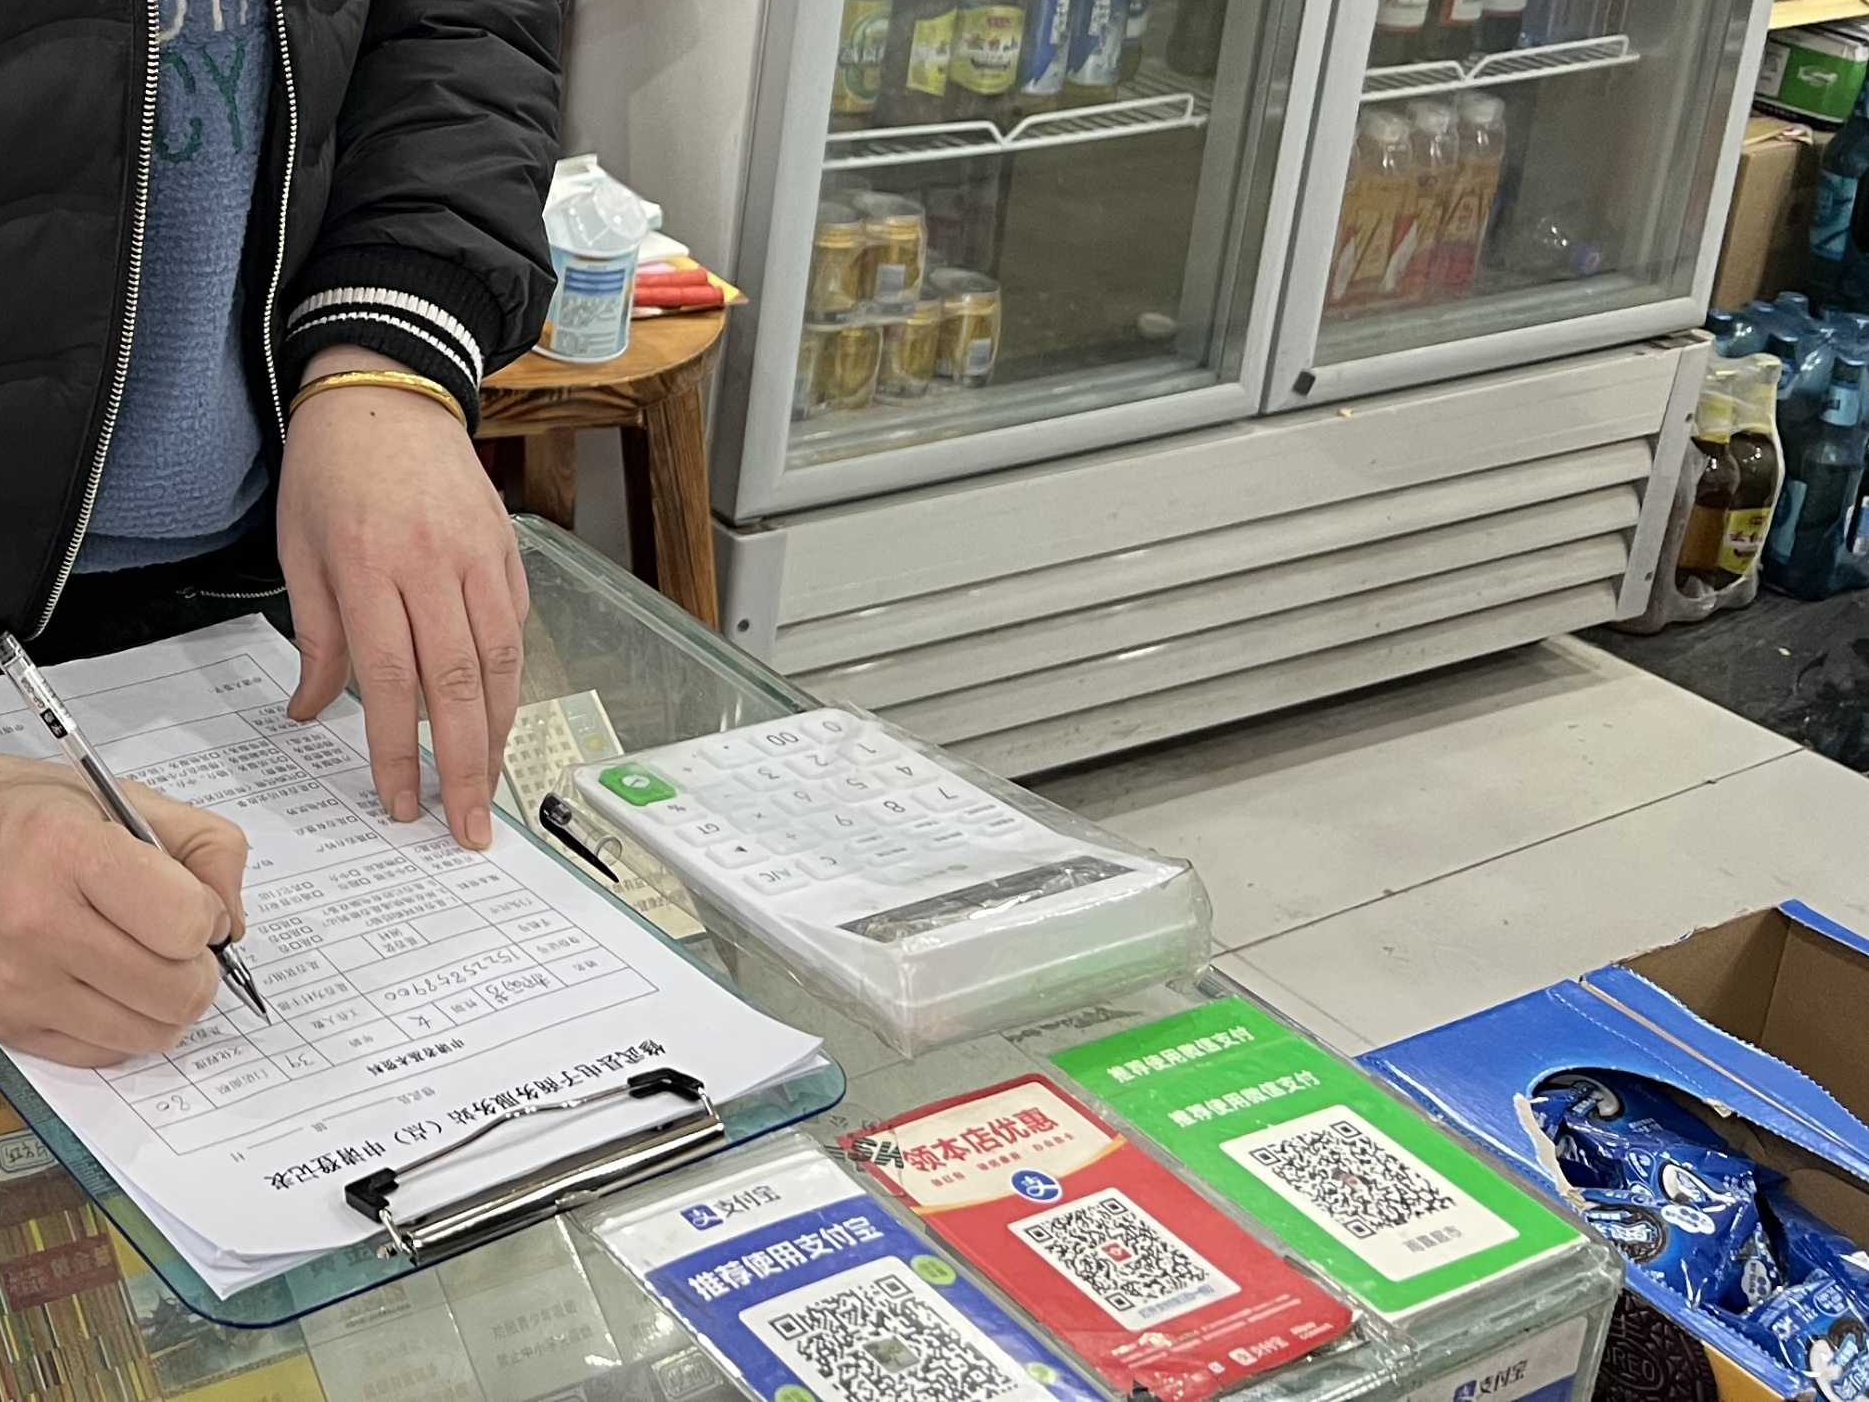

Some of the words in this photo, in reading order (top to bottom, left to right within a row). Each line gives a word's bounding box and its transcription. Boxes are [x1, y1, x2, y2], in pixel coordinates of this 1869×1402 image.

[821, 720, 843, 734] 0
[765, 731, 800, 747] 00
[804, 753, 830, 767] 2
[757, 766, 781, 781] 3
[894, 764, 914, 778] 4
[844, 776, 869, 791] 5
[792, 790, 813, 804] 6
[882, 799, 906, 814] 8
[833, 812, 854, 828] 9
[407, 1013, 432, 1029] 女
[283, 1053, 315, 1070] 39
[366, 1038, 465, 1077] 申请者基本资料
[1106, 1025, 1255, 1084] 推荐使用微信支付
[1167, 1069, 1321, 1129] 推荐使用微信支付
[901, 1106, 1059, 1173] 领本店优惠
[713, 1184, 782, 1220] 支付宝
[687, 1215, 885, 1302] 推荐使用支付宝
